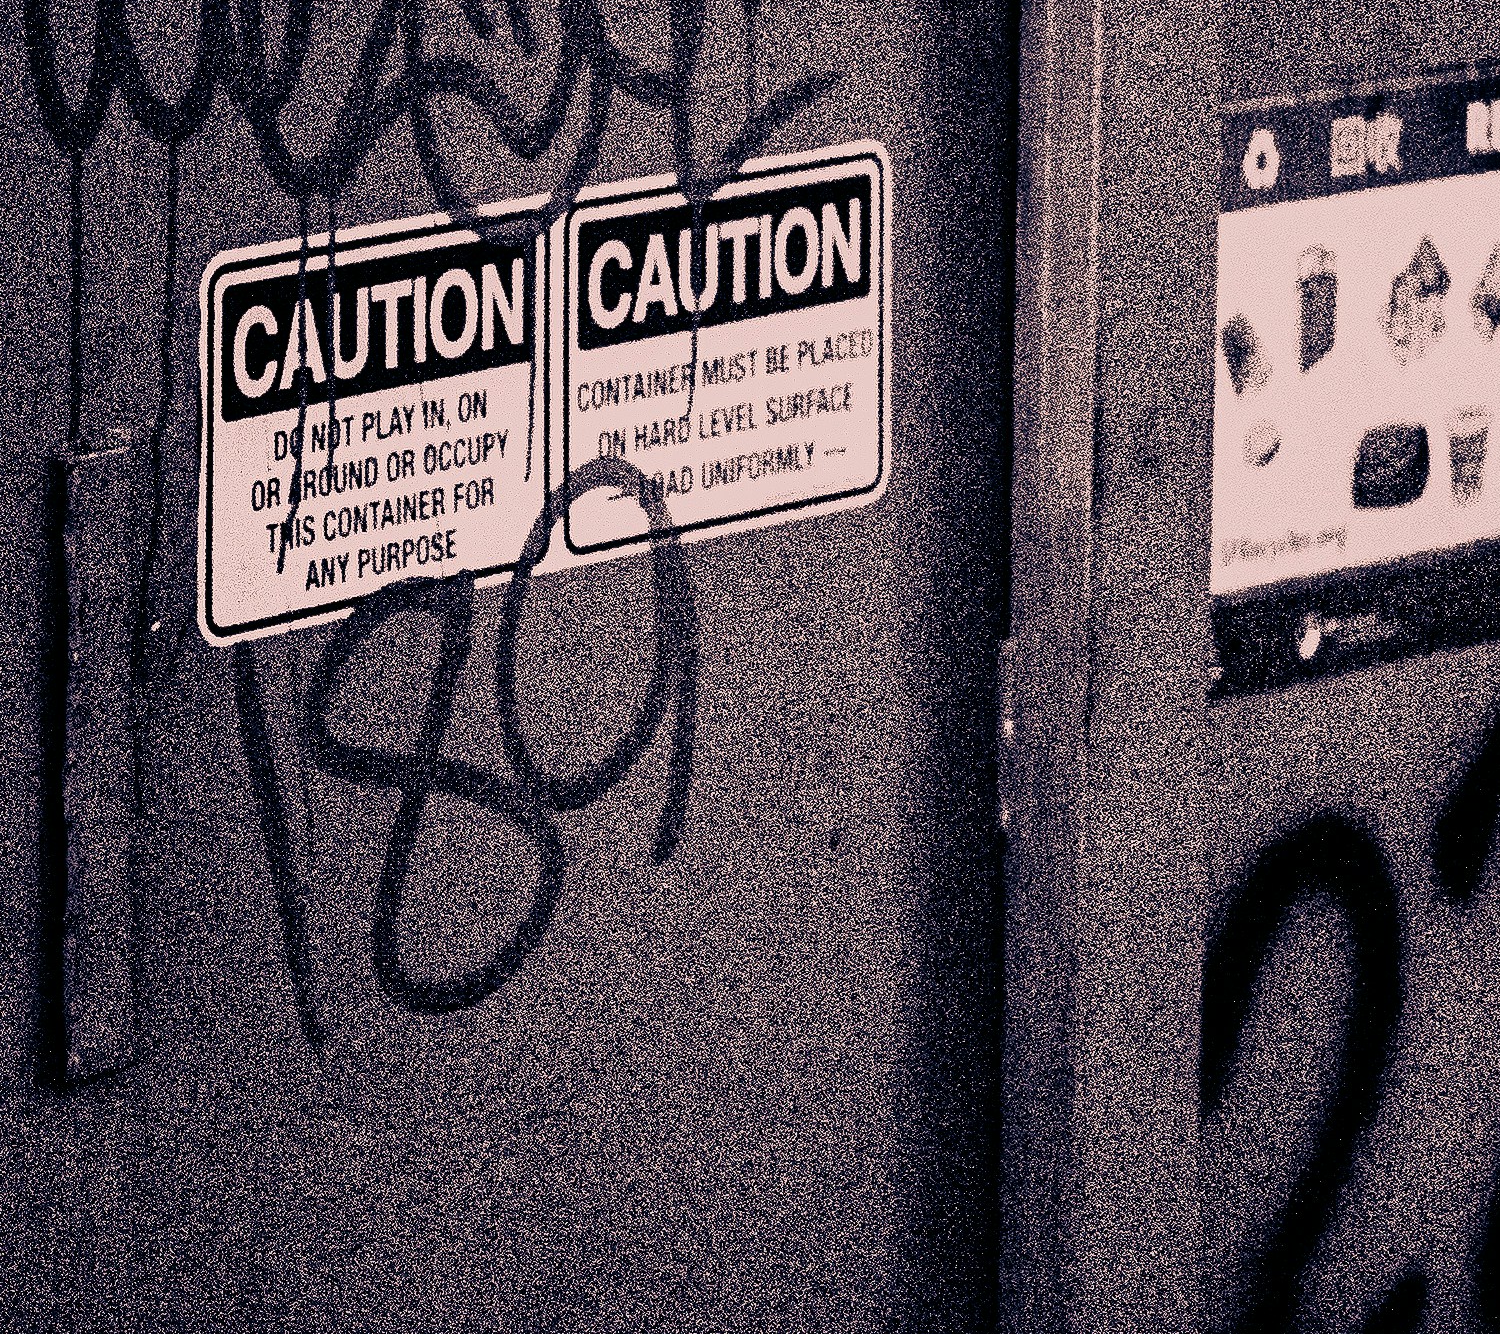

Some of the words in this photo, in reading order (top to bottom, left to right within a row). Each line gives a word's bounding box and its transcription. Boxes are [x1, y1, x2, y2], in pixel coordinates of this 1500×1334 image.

[586, 197, 863, 333] CAUTION
[232, 257, 526, 401] CAUTION
[577, 361, 696, 413] CONTAINER
[701, 349, 757, 387] MUST
[766, 343, 789, 375] BE
[797, 328, 874, 369] PLACED
[273, 427, 301, 461] DO
[311, 415, 354, 452] NOT
[362, 404, 415, 442] PLAY
[458, 390, 487, 422] ON
[598, 429, 626, 460] ON
[634, 416, 691, 453] HARD
[699, 402, 758, 441] LEVEL
[766, 381, 854, 426] SURFACE
[251, 478, 280, 511] OR
[387, 450, 415, 482] OR
[423, 429, 508, 474] OCCUPY
[701, 441, 816, 490] UNIFORMLY
[266, 515, 315, 553] THIS
[324, 487, 444, 541] CONTAINER
[454, 477, 494, 512] FOR
[306, 552, 349, 591] ANY
[358, 529, 456, 578] PURPOSE
